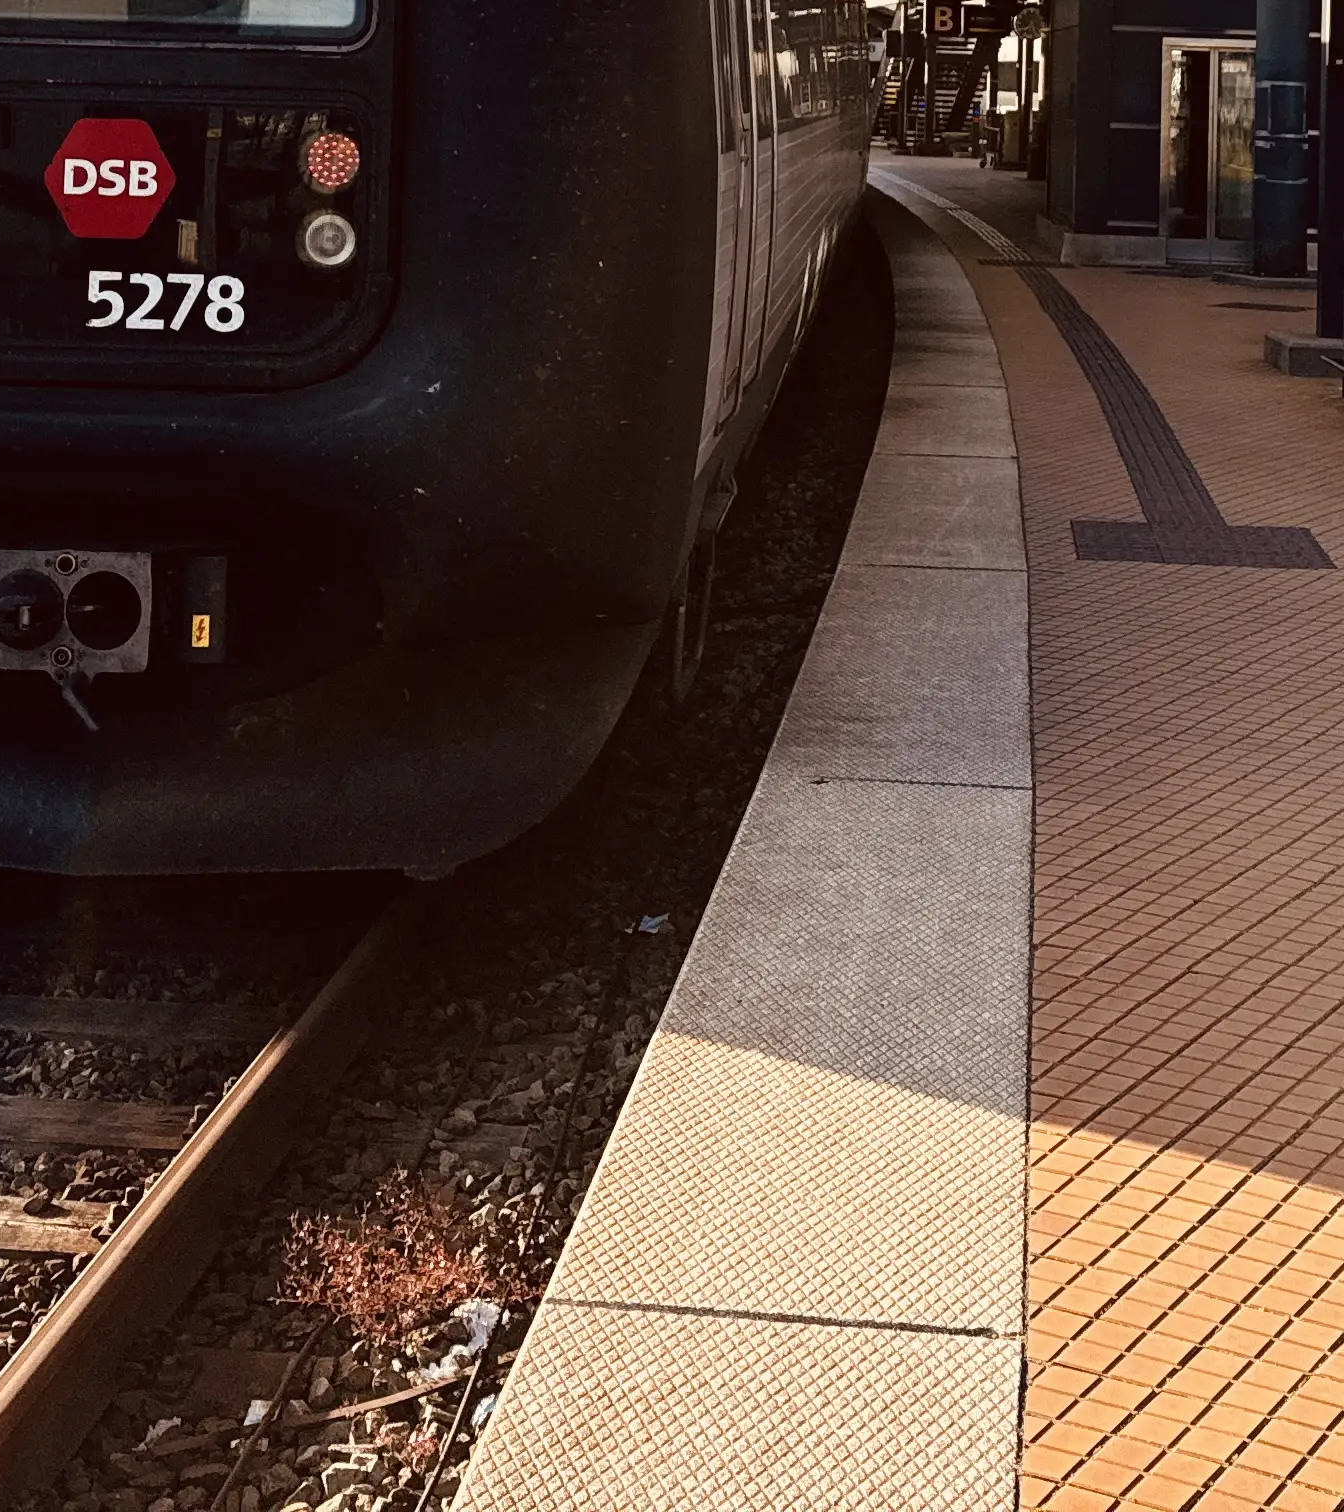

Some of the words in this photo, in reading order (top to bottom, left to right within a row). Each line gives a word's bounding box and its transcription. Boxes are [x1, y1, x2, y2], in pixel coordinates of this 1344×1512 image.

[934, 6, 953, 31] B
[61, 158, 159, 198] DSB
[85, 270, 246, 332] 5278
